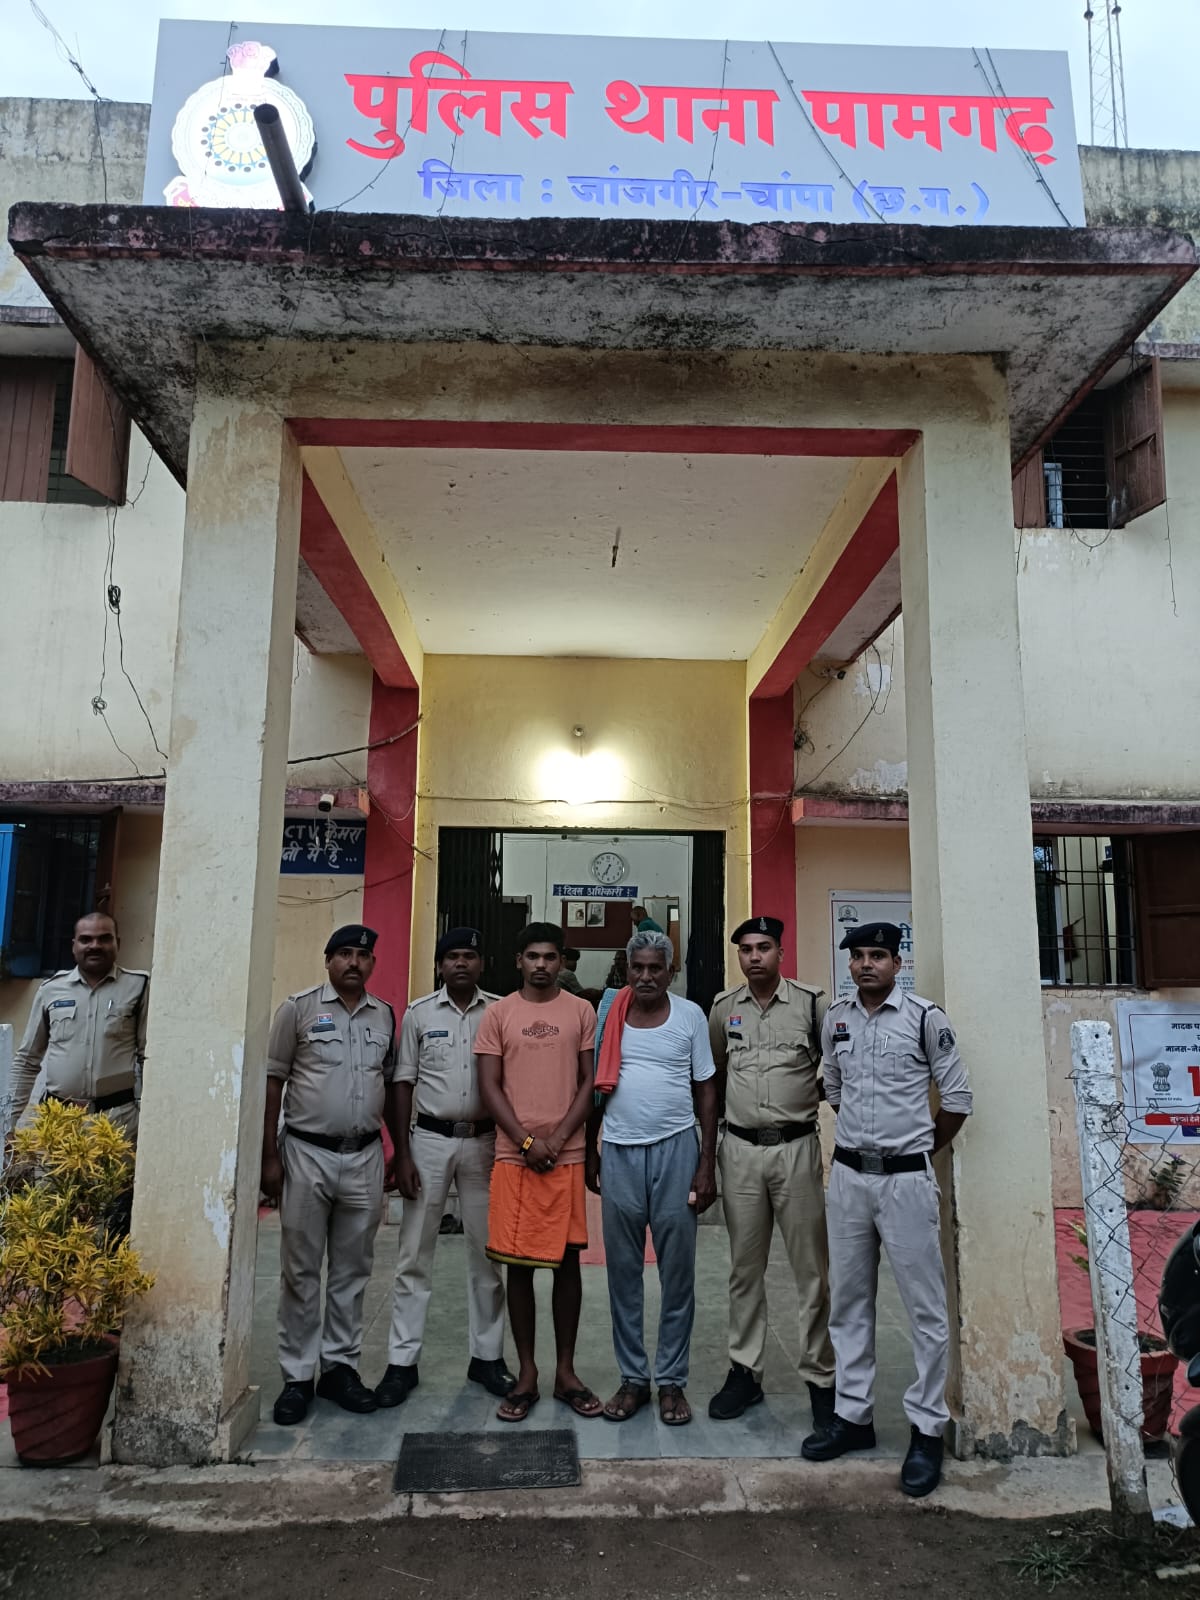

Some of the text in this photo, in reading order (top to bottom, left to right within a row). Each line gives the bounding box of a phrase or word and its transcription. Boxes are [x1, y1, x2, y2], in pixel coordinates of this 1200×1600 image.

[344, 50, 1057, 166] पुलिस थाना पामगढ़
[417, 158, 525, 204] जिला
[566, 164, 836, 214] जांजगीर-चांपा
[284, 825, 320, 840] CTV
